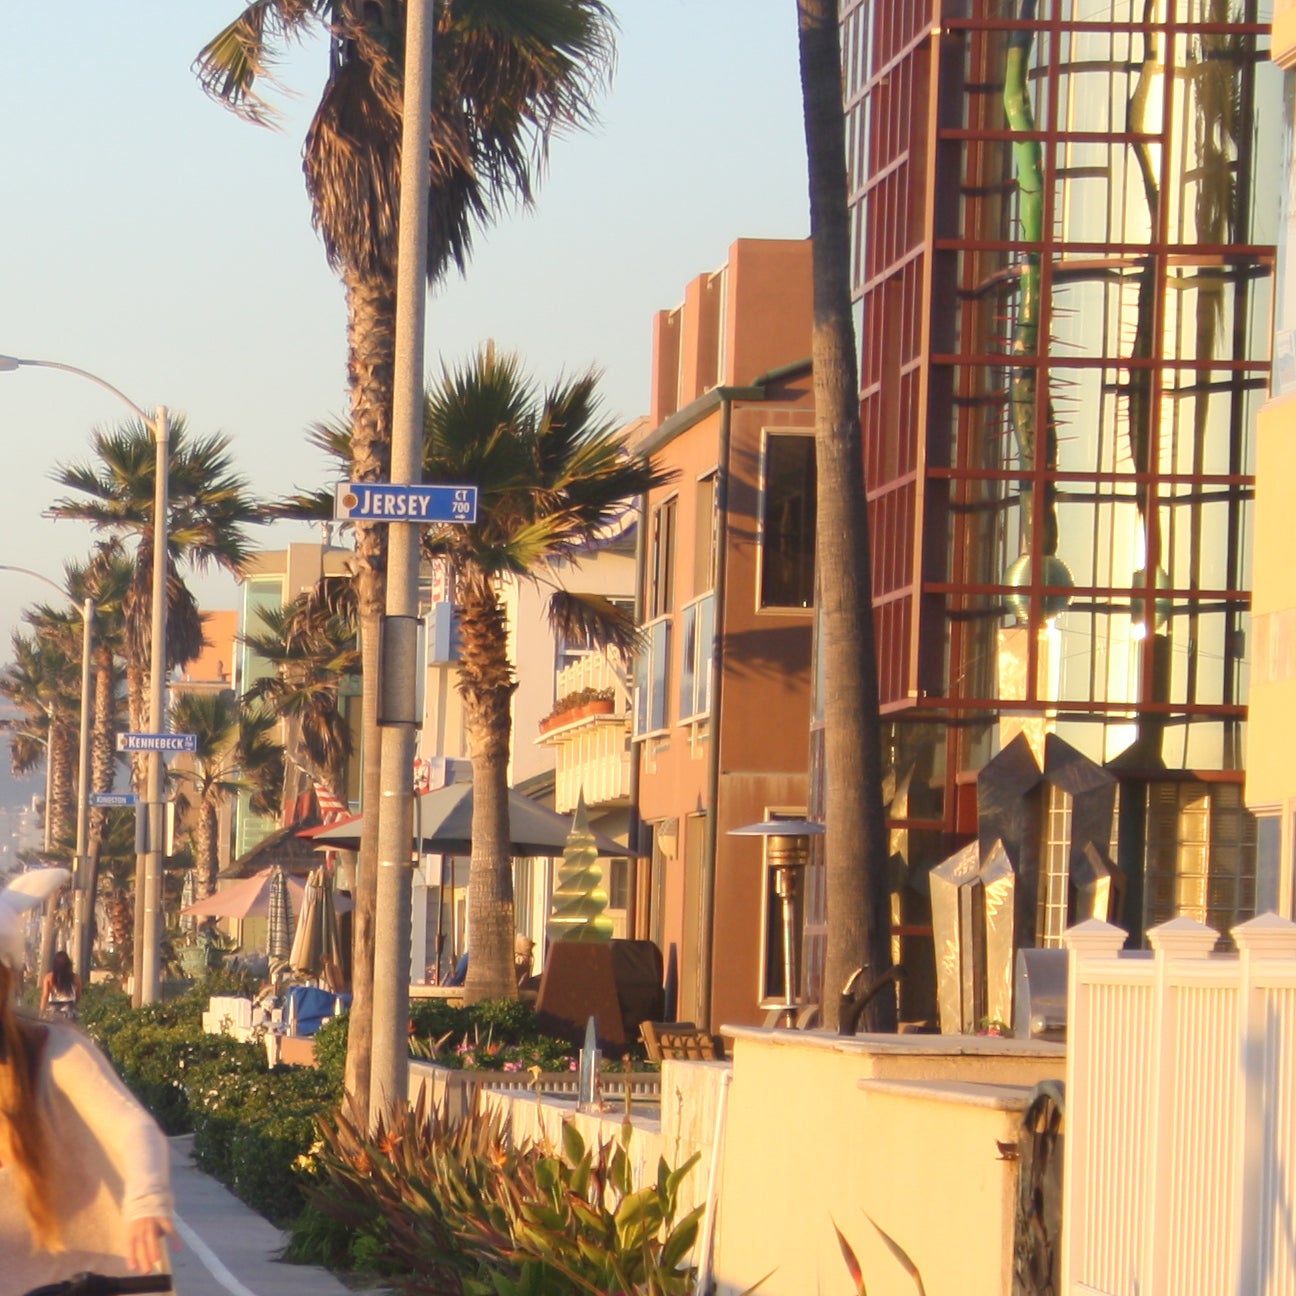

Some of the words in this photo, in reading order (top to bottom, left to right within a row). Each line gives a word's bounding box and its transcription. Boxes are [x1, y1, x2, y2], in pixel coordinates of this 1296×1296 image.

[454, 490, 468, 501] CT
[360, 490, 431, 516] JERSEY
[452, 502, 470, 514] 700
[128, 736, 184, 749] KENNEBECK
